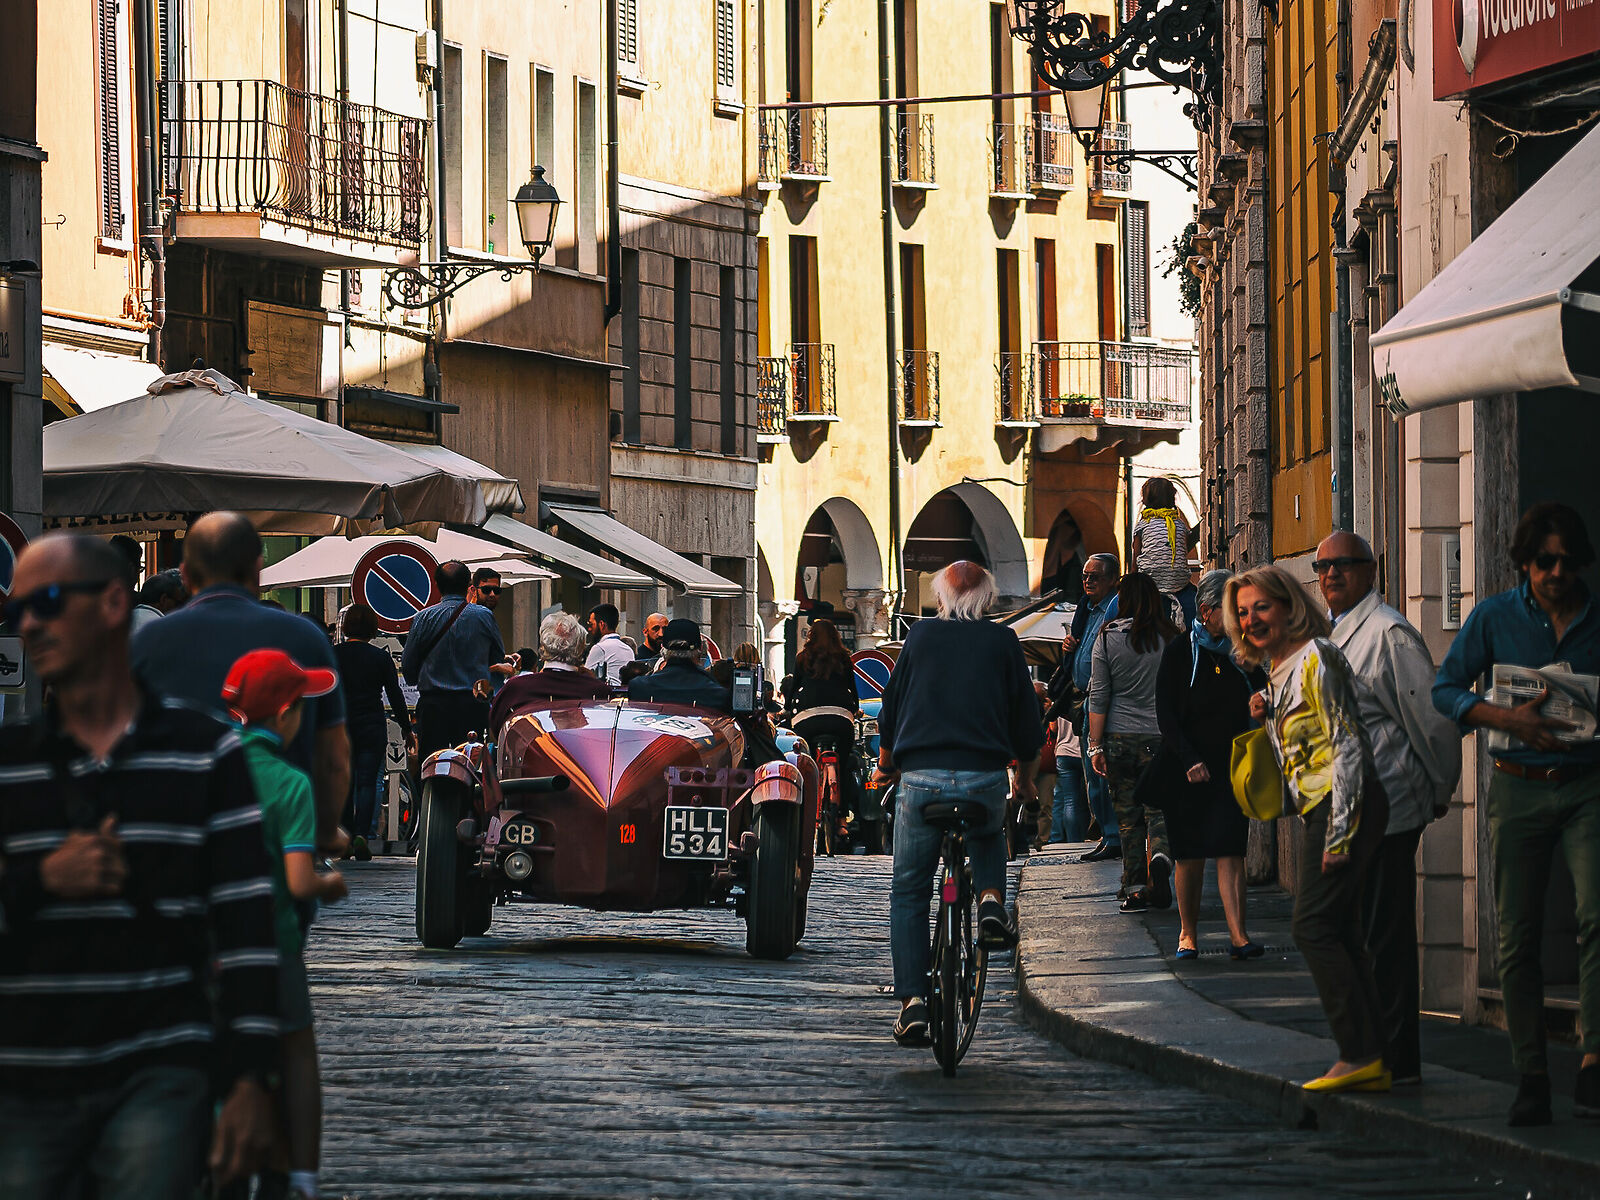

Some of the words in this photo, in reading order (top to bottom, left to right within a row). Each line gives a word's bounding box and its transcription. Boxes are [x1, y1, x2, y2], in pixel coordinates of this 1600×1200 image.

[671, 811, 722, 833] HLL
[505, 824, 535, 845] GB
[619, 823, 636, 844] 128
[670, 833, 722, 856] 534
